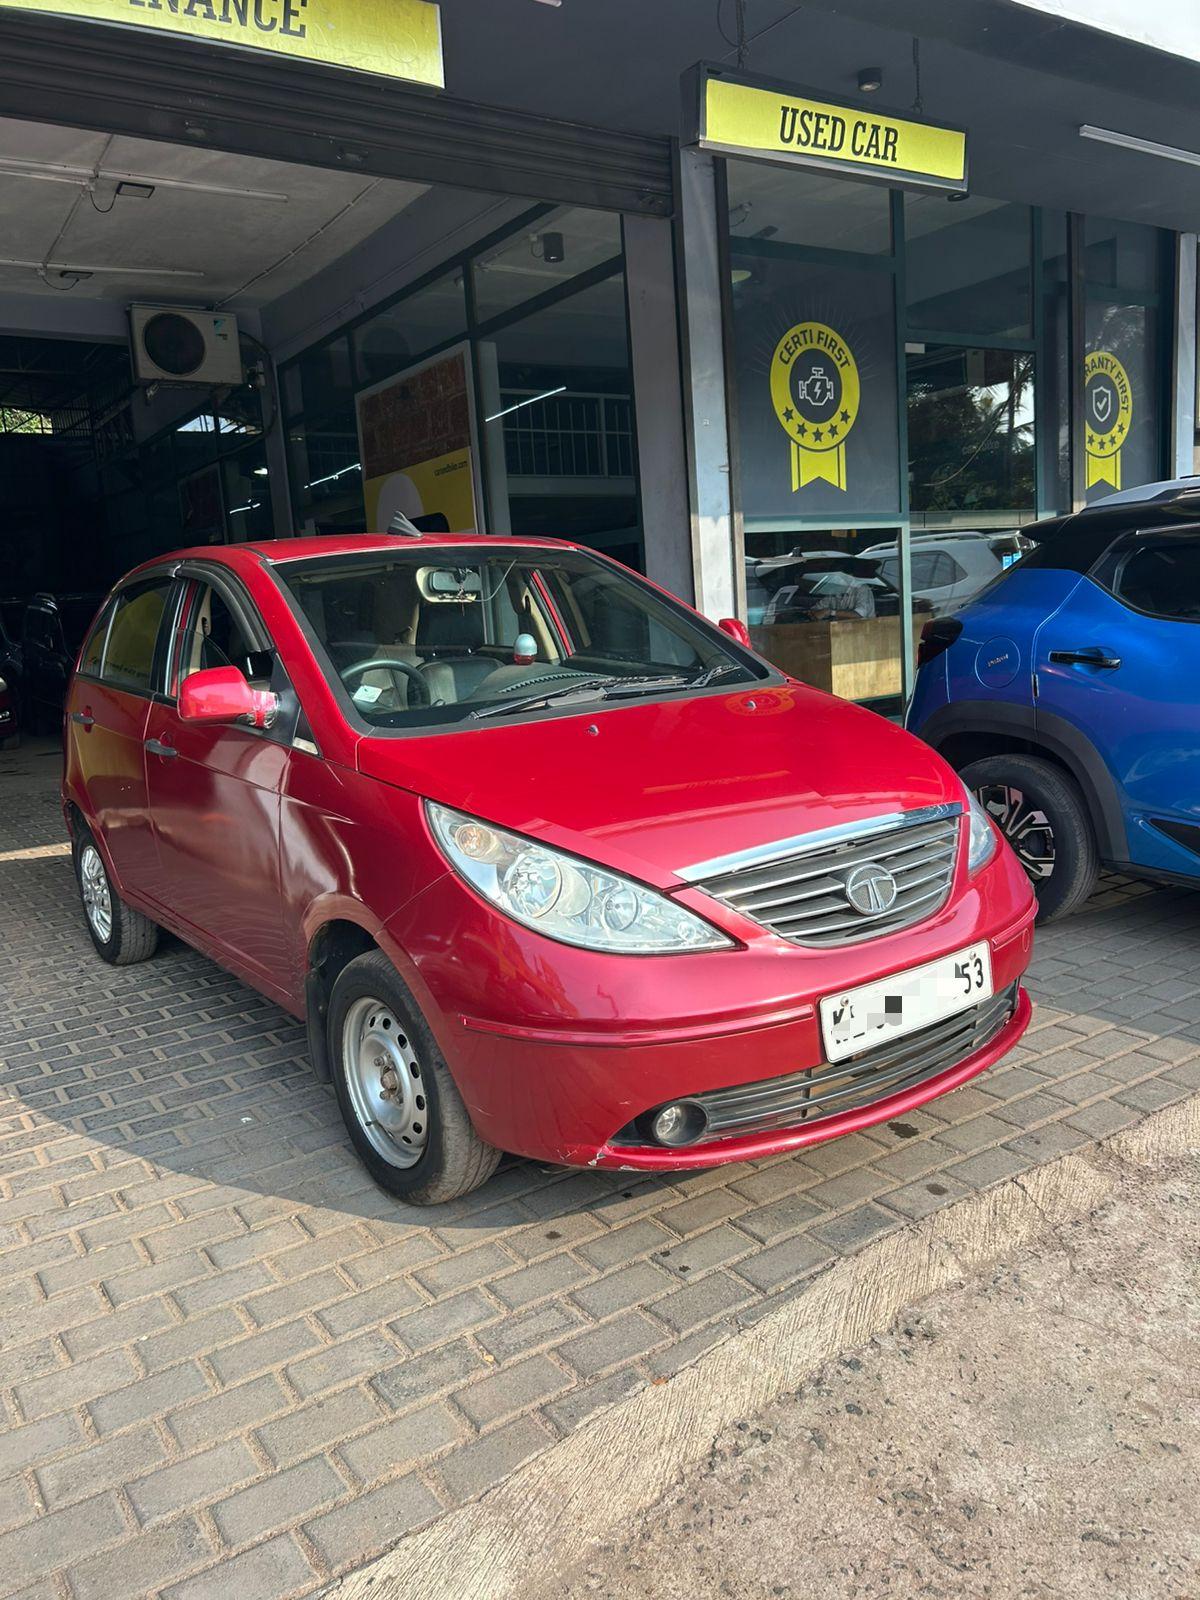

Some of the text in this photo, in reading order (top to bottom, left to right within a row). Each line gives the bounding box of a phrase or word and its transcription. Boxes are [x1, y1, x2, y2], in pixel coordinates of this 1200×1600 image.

[129, 0, 306, 38] ANCE
[779, 106, 899, 163] USED CAR
[778, 329, 851, 369] CERTI FIRST
[1115, 370, 1129, 414] FIRST
